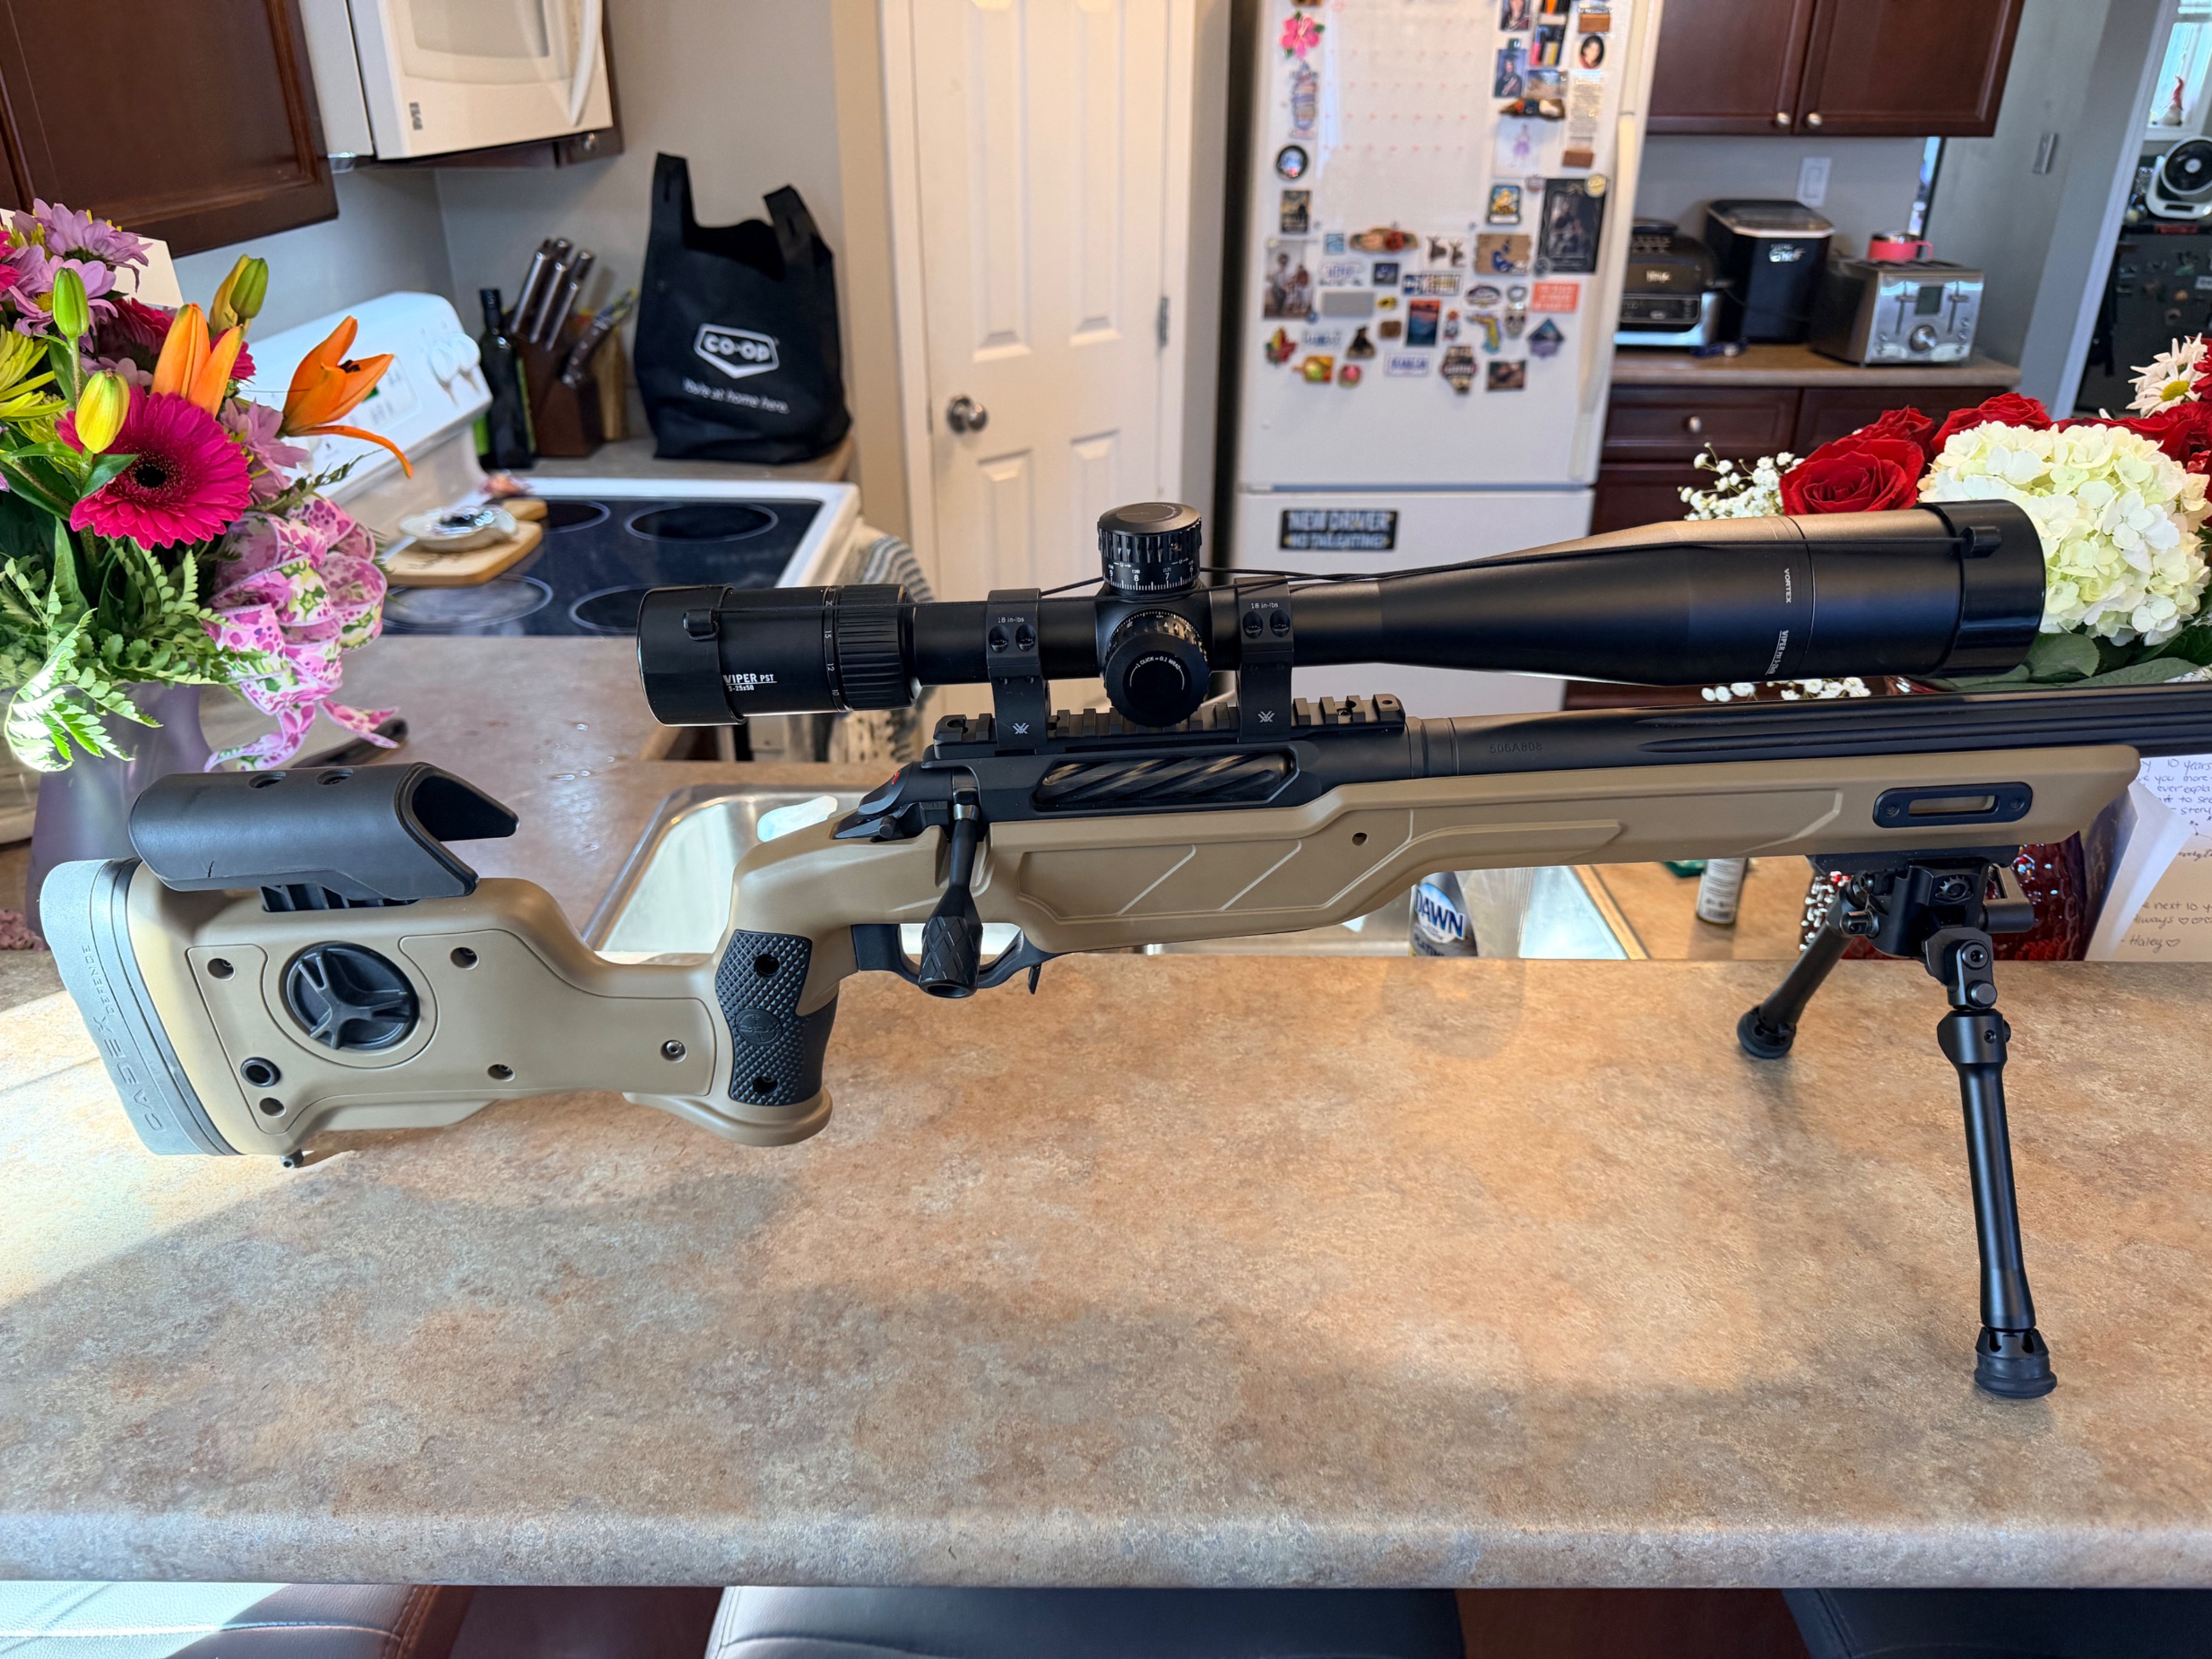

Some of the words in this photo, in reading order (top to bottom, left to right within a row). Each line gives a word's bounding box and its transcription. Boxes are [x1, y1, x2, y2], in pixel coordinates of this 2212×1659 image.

[704, 333, 771, 362] CO-OP
[1133, 573, 1140, 582] 8
[1783, 567, 1792, 603] VORTEX
[824, 630, 832, 639] 15
[1779, 630, 1789, 651] VIPER
[1140, 656, 1154, 665] CLICK
[827, 663, 835, 672] 12
[723, 673, 757, 683] VIPER
[759, 674, 775, 682] PST
[2167, 758, 2180, 768] 10
[2183, 760, 2212, 776] years
[2154, 775, 2175, 785] you
[2183, 784, 2212, 795] expla
[2153, 902, 2182, 910] next
[2186, 902, 2198, 911] 10
[1416, 887, 1464, 938] DAWN
[2129, 934, 2164, 954] Haley
